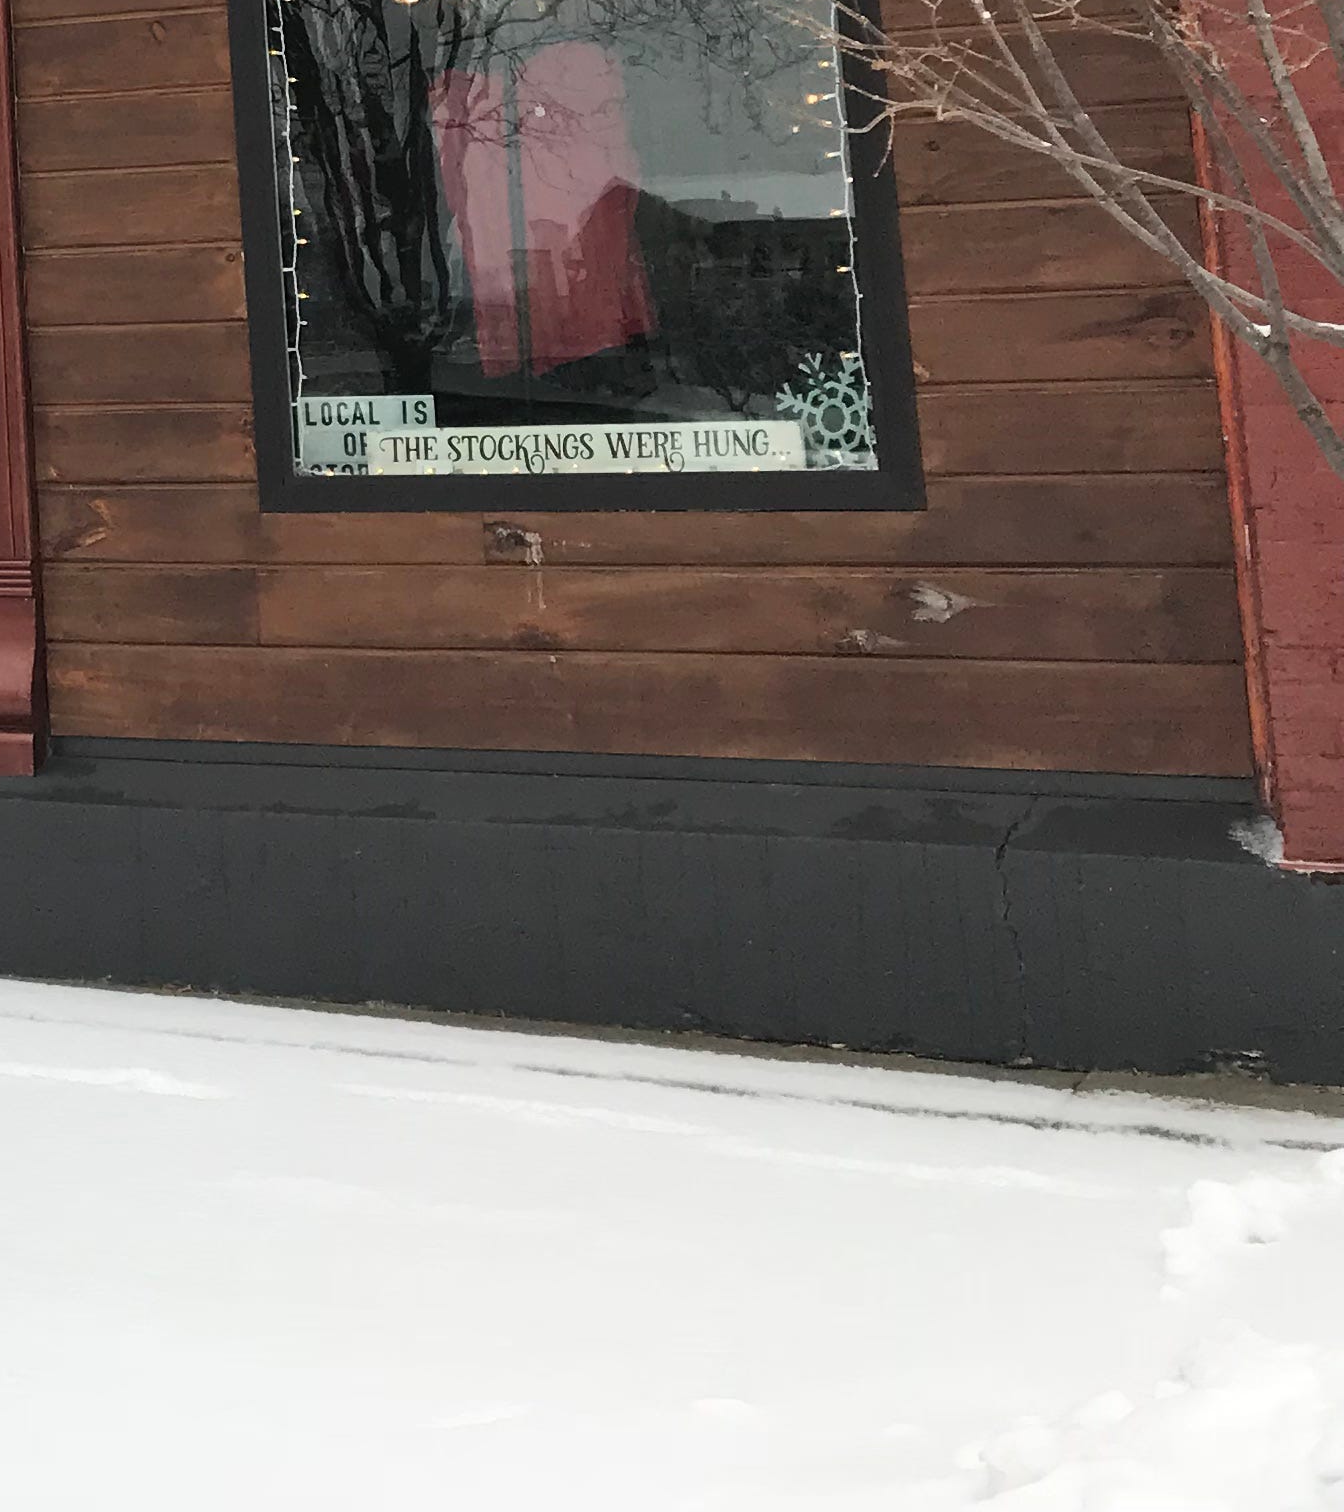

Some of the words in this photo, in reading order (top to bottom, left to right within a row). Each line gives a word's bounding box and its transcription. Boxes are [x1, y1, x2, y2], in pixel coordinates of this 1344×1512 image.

[304, 401, 381, 426] LOCAL
[402, 400, 428, 425] IS
[379, 435, 438, 462] THE
[447, 433, 593, 475] STOCKINGS
[605, 430, 685, 473] WERE
